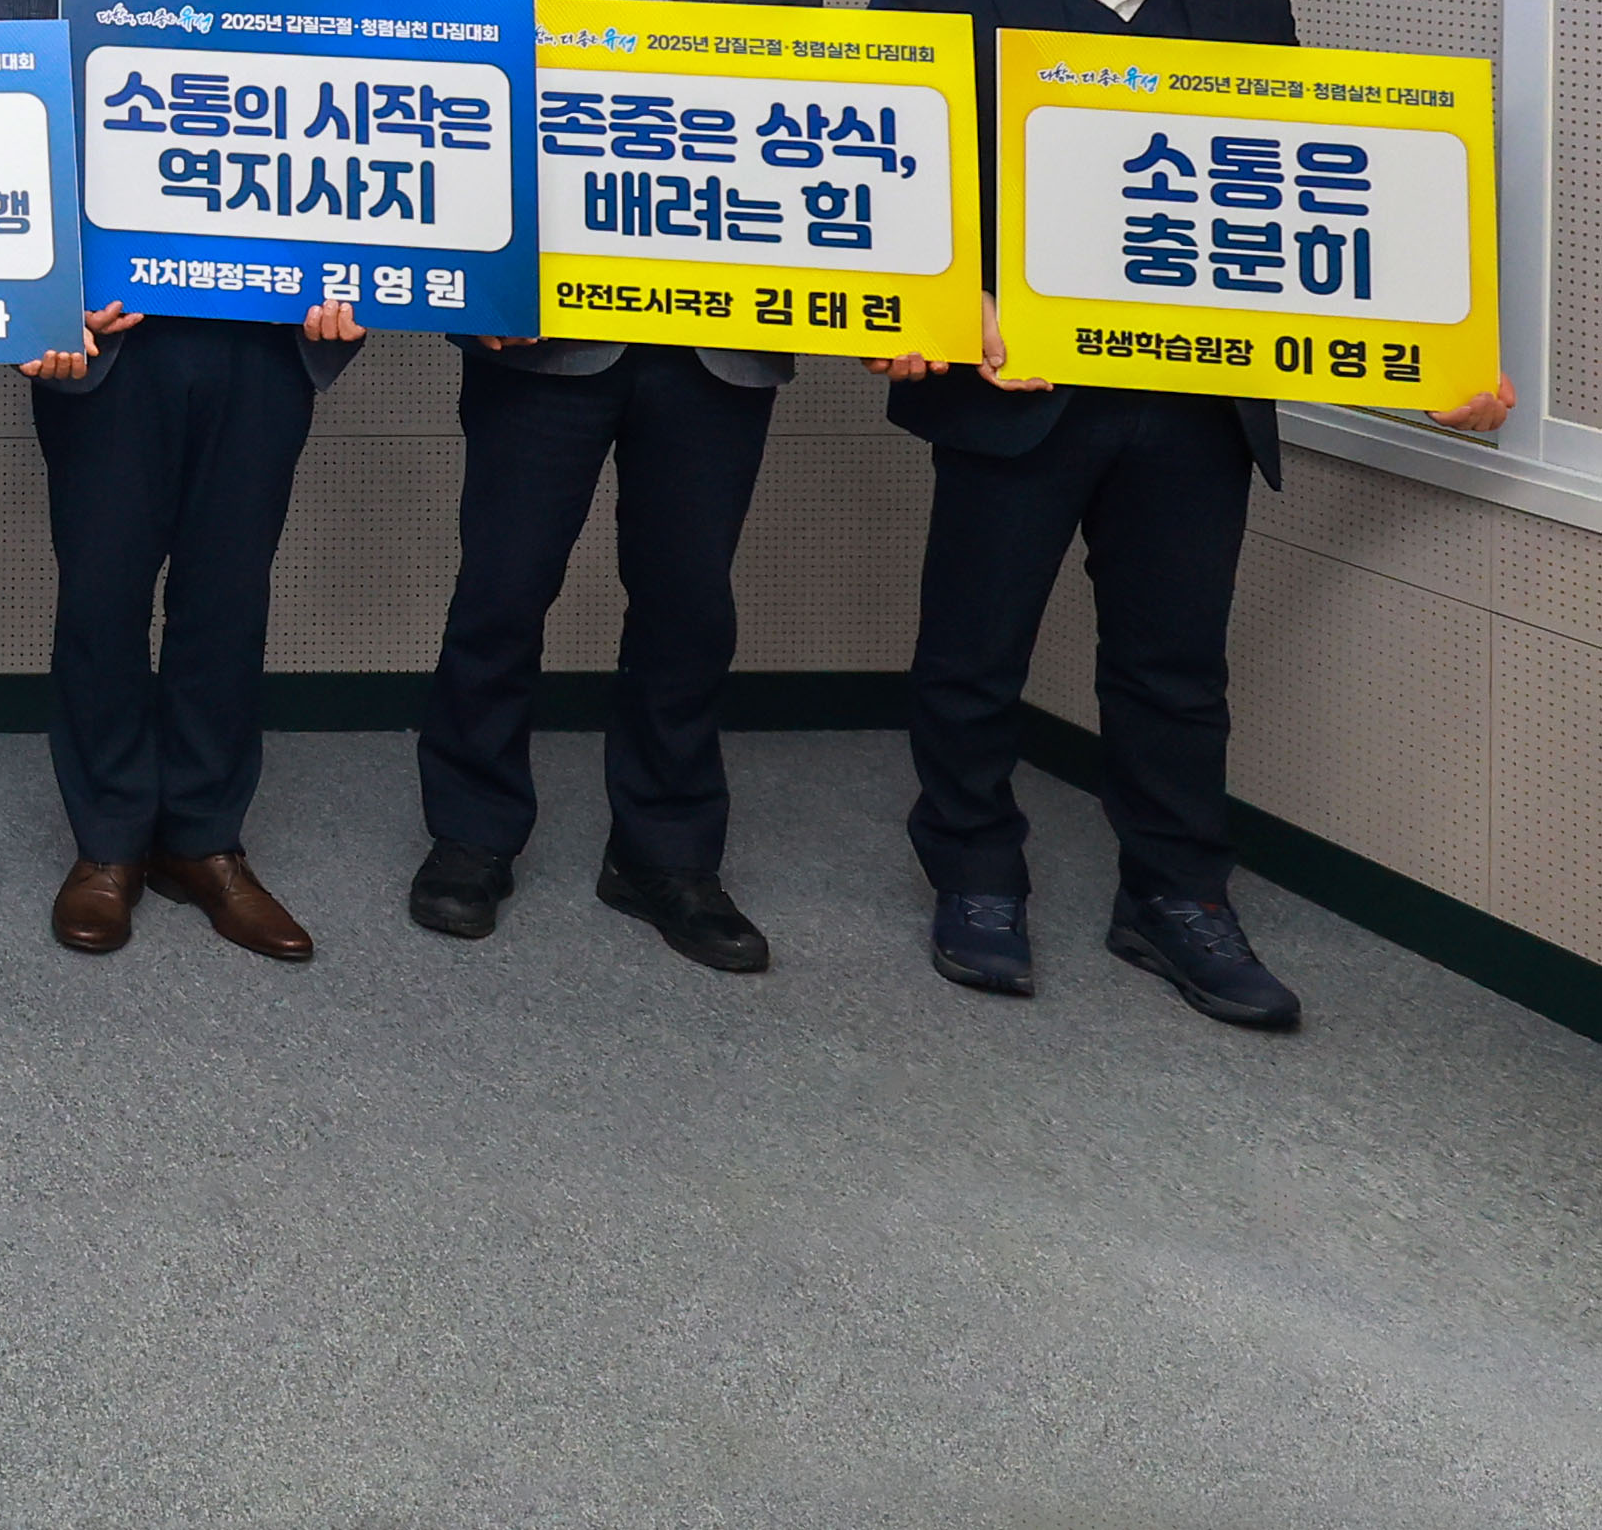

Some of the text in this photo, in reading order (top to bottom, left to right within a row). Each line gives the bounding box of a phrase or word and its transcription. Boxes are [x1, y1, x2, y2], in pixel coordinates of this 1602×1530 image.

[222, 13, 282, 33] 2025년
[432, 20, 499, 42] 다짐대회
[647, 34, 709, 54] 2025년
[866, 44, 935, 64] 다짐대회
[104, 71, 493, 151] 소통의 시작은
[1169, 73, 1231, 94] 2025년
[1386, 86, 1454, 108] 다짐대회
[539, 92, 917, 178] 존중은 상식,
[158, 148, 435, 225] 역지사지
[1123, 132, 1371, 216] 소통은
[584, 171, 872, 250] 배려는 힘
[130, 256, 303, 295] 자치행정국장
[1123, 213, 1371, 300] 충분히
[557, 281, 734, 318] 안전도시국장
[1074, 327, 1253, 366] 평생학습원장
